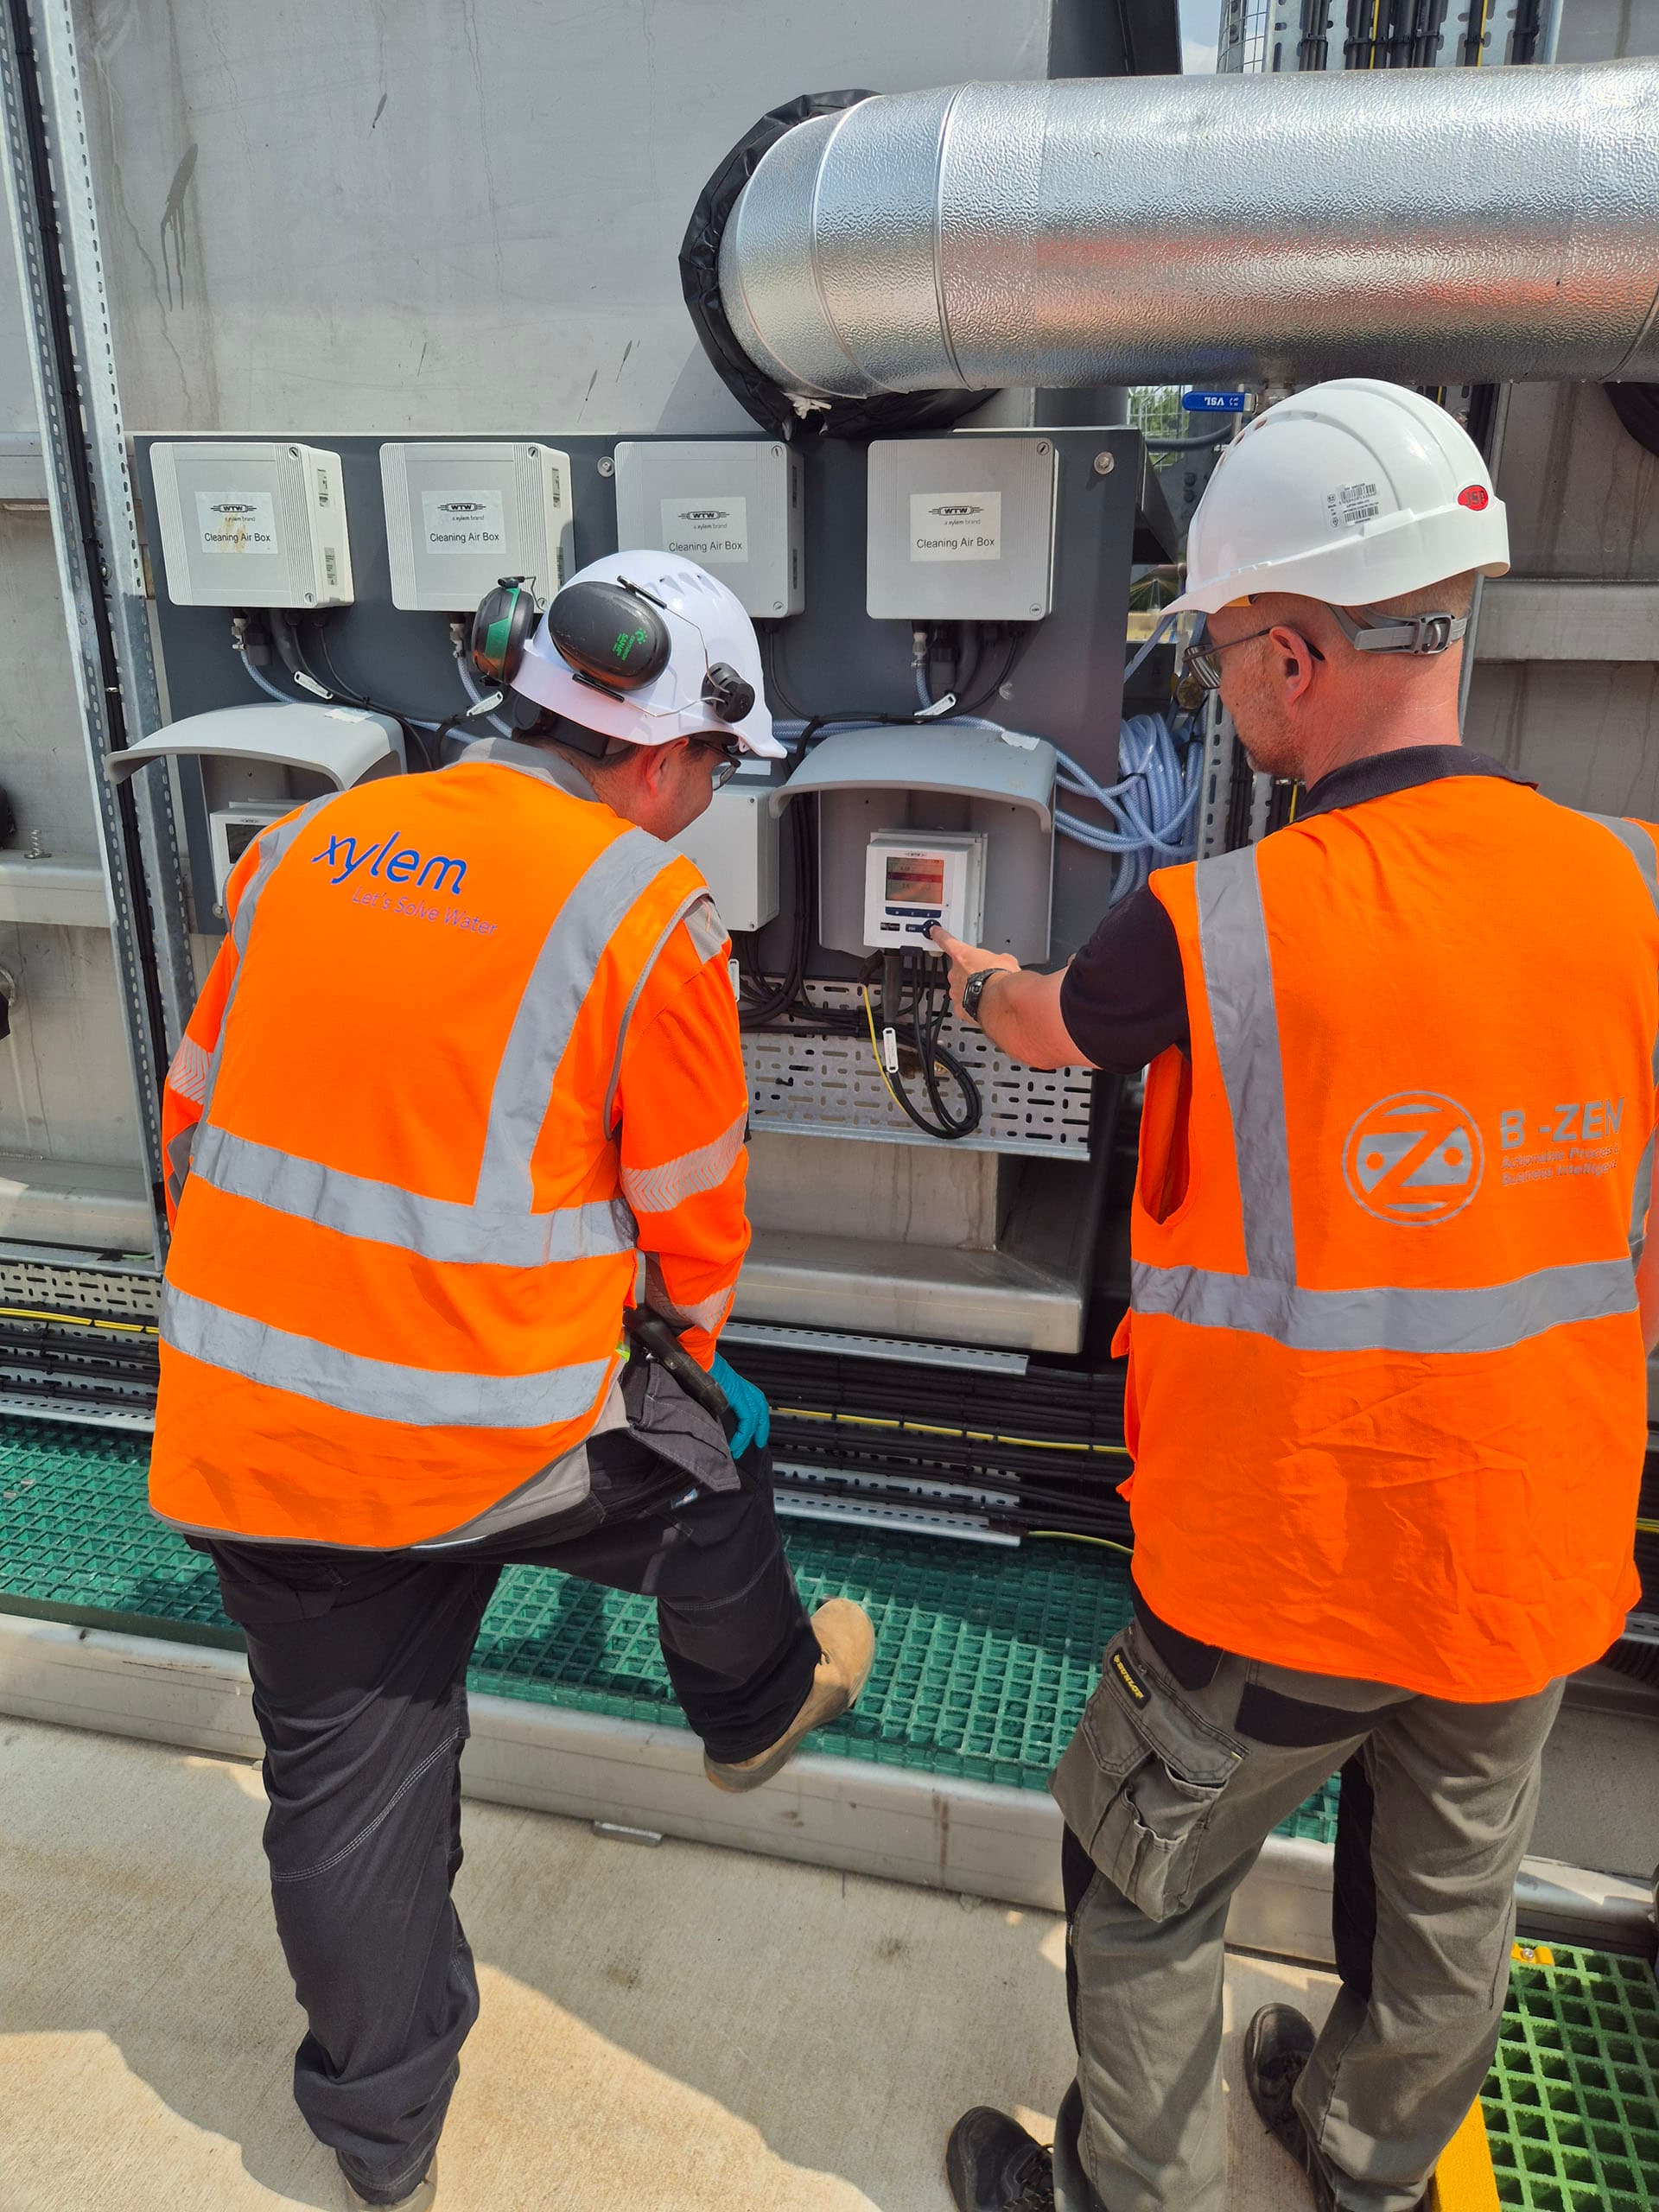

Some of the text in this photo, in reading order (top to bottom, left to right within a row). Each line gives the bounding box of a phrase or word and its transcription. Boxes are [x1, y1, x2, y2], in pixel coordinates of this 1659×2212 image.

[204, 532, 238, 543] Cleaning
[254, 532, 270, 542] Box
[429, 531, 499, 543] Cleaning Air Box
[916, 537, 995, 550] Cleaning Air Box
[669, 541, 742, 553] Cleaning Air Box
[310, 830, 468, 895] xylem
[351, 886, 499, 937] Let's Solve Water
[1501, 1149, 1565, 1170] Actionable
[1501, 1167, 1554, 1187] Business
